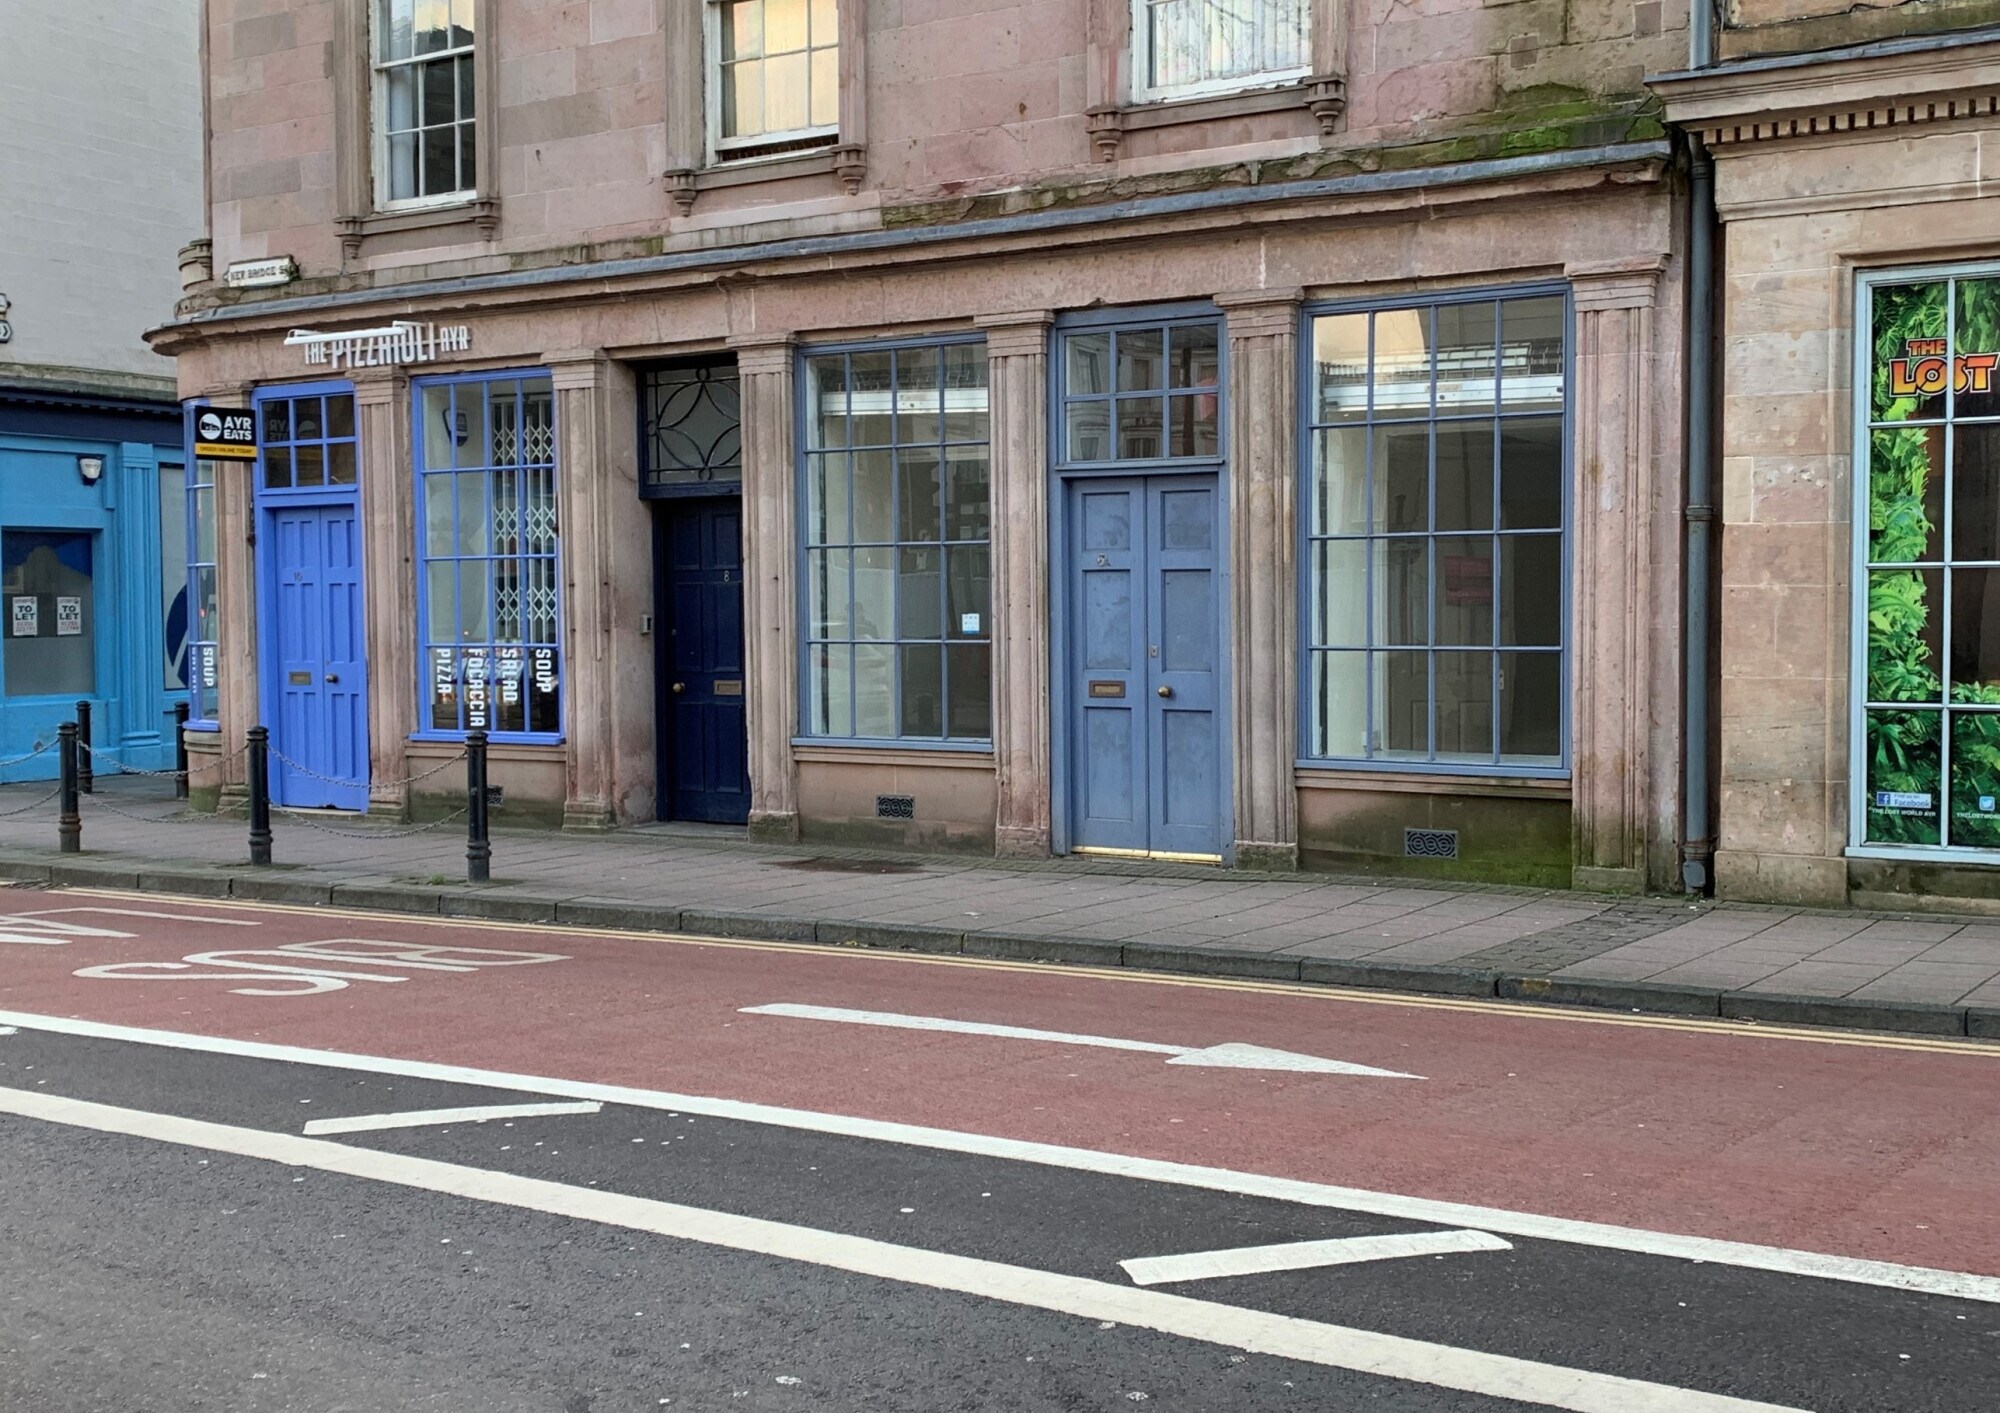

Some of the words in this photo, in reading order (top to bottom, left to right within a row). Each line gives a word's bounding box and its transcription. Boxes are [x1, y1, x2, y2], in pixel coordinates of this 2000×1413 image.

[230, 270, 245, 280] NEW
[247, 266, 276, 279] BRIDGE
[440, 325, 469, 352] AYR
[1907, 338, 1946, 357] THE
[1890, 352, 2000, 397] LOST
[223, 415, 252, 430] AYR
[223, 429, 253, 441] EATS
[723, 569, 730, 582] 8
[15, 612, 35, 621] LET
[17, 605, 33, 613] TO
[59, 612, 79, 620] LET
[61, 605, 76, 613] TO
[203, 647, 214, 687] SOUP
[436, 648, 452, 694] PIZZA
[502, 648, 518, 702] SALAD
[535, 648, 552, 693] SOUP
[468, 648, 485, 727] FOCACCIA
[1894, 798, 1929, 807] Facebook
[70, 938, 574, 998] BUS
